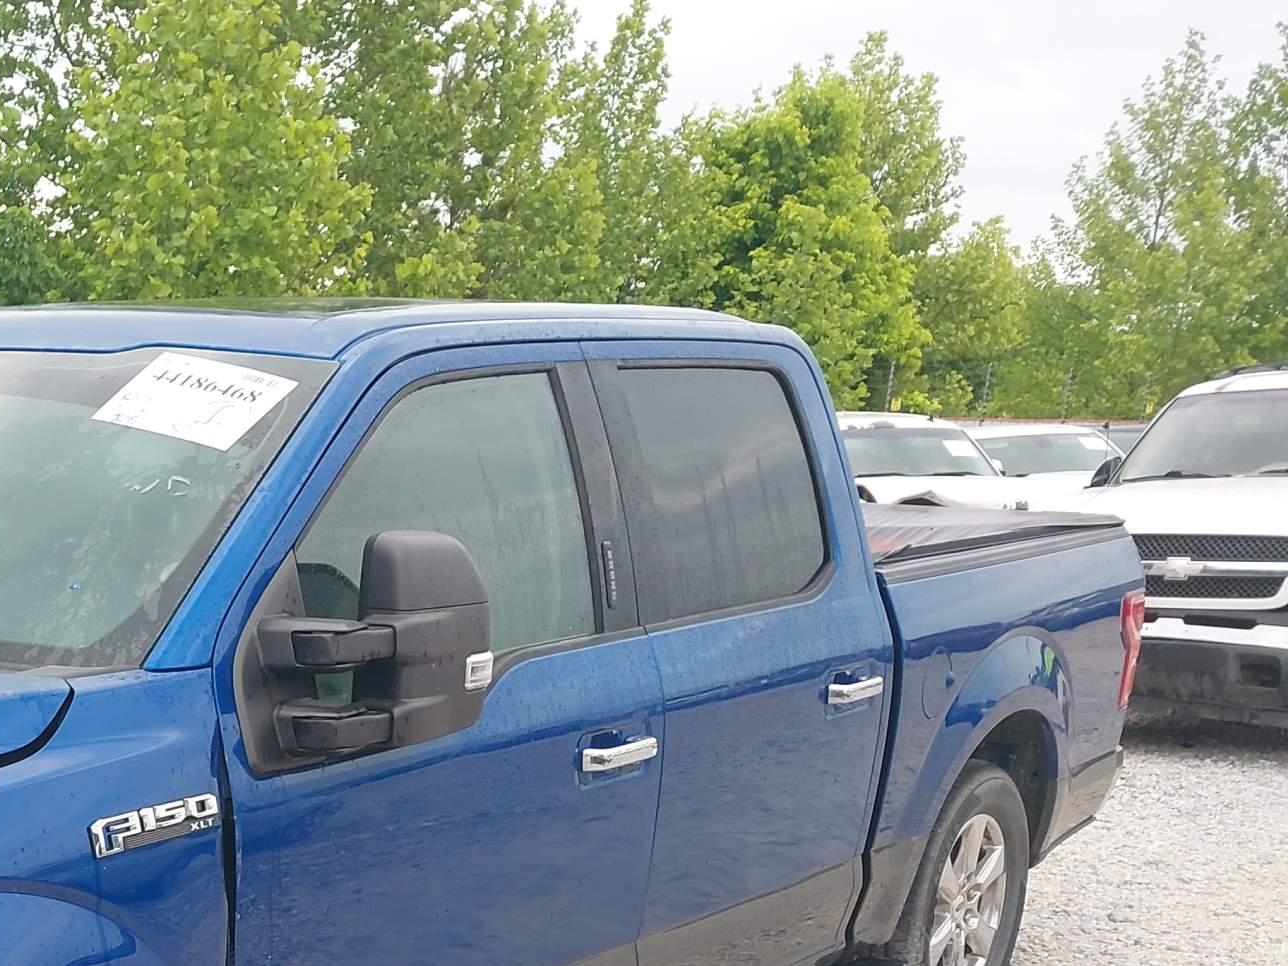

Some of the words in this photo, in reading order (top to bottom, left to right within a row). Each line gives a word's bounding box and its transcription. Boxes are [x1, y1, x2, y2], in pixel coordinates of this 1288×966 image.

[153, 370, 263, 403] 44186468
[90, 793, 219, 858] F150
[190, 817, 215, 832] XLT
